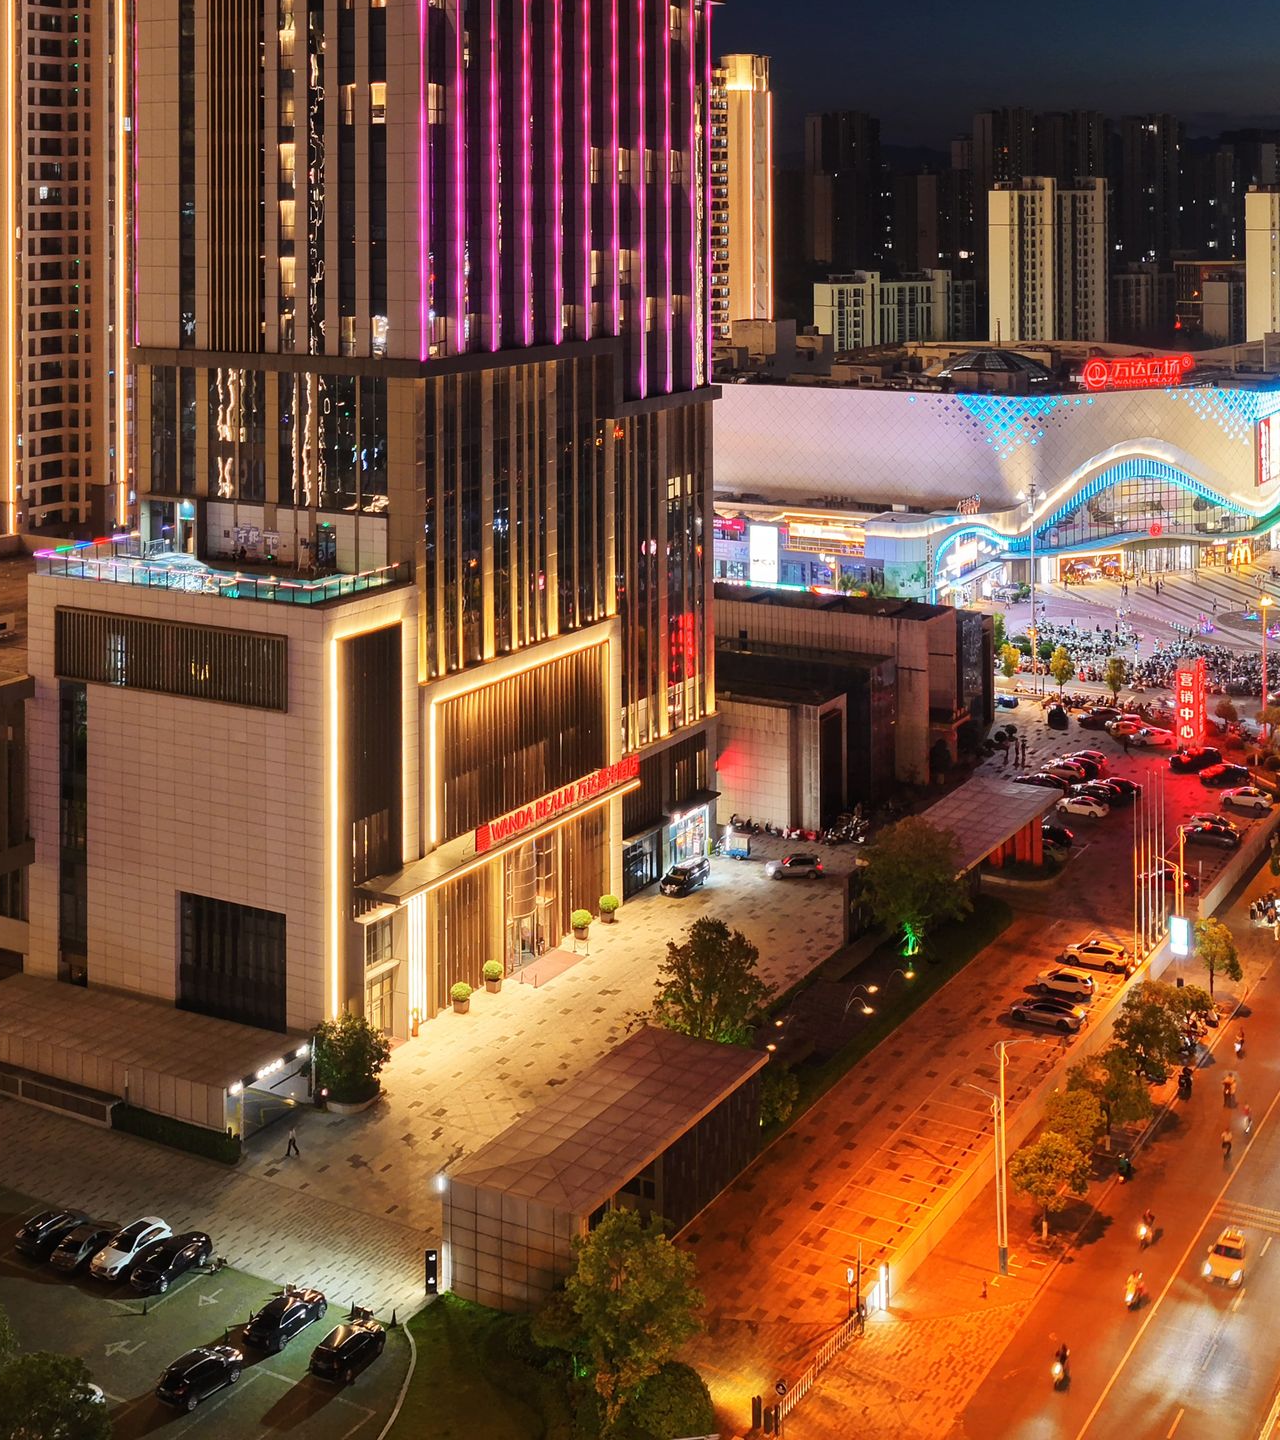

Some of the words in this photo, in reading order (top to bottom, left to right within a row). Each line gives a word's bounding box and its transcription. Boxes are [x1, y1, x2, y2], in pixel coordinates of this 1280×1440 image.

[1113, 359, 1181, 377] 万达广场
[1149, 376, 1180, 384] PLAZA
[1179, 673, 1194, 739] 营销中心
[491, 807, 534, 841] WANDA
[535, 785, 574, 820] REALM
